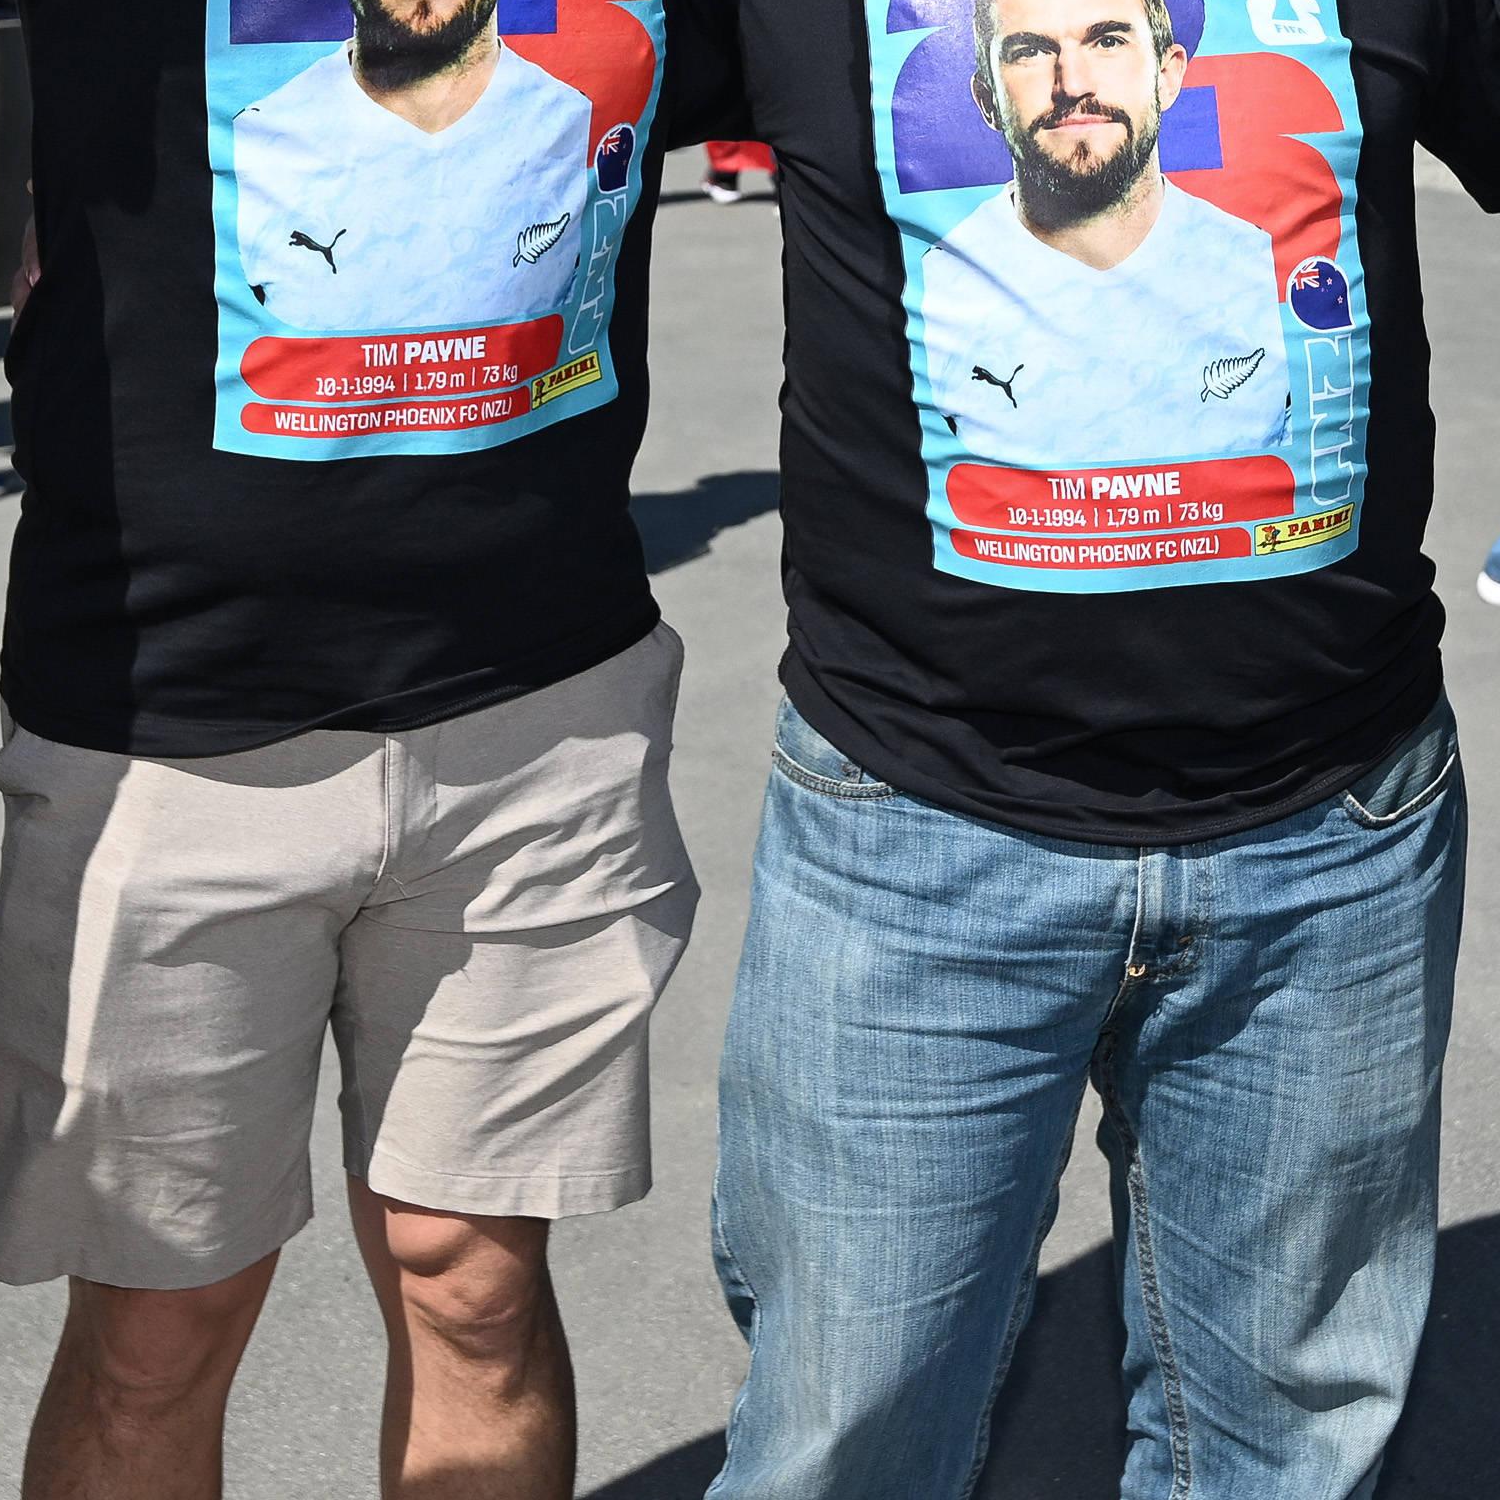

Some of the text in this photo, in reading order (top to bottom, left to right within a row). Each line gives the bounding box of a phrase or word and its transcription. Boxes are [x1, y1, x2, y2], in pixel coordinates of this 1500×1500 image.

[1274, 22, 1307, 36] FIFA
[361, 335, 487, 368] TIM PAYNE
[315, 374, 396, 397] 10-1-1994
[414, 371, 447, 392] 1,79
[449, 372, 465, 389] m
[482, 365, 500, 385] 73
[502, 363, 518, 383] kg
[548, 356, 597, 388] PANINI
[274, 397, 512, 433] WELLINGTON PHOENIX FC (NZL)
[1047, 471, 1181, 501] TIM PAYNE
[1007, 506, 1088, 528] 10-1-1994
[1106, 507, 1140, 529] 1,79
[1142, 508, 1160, 525] m
[1178, 502, 1200, 522] 73
[1201, 500, 1224, 522] kg
[1287, 508, 1353, 538] PANINI
[973, 534, 1220, 564] WELLINGTON PHOENIX FC (NZL)
